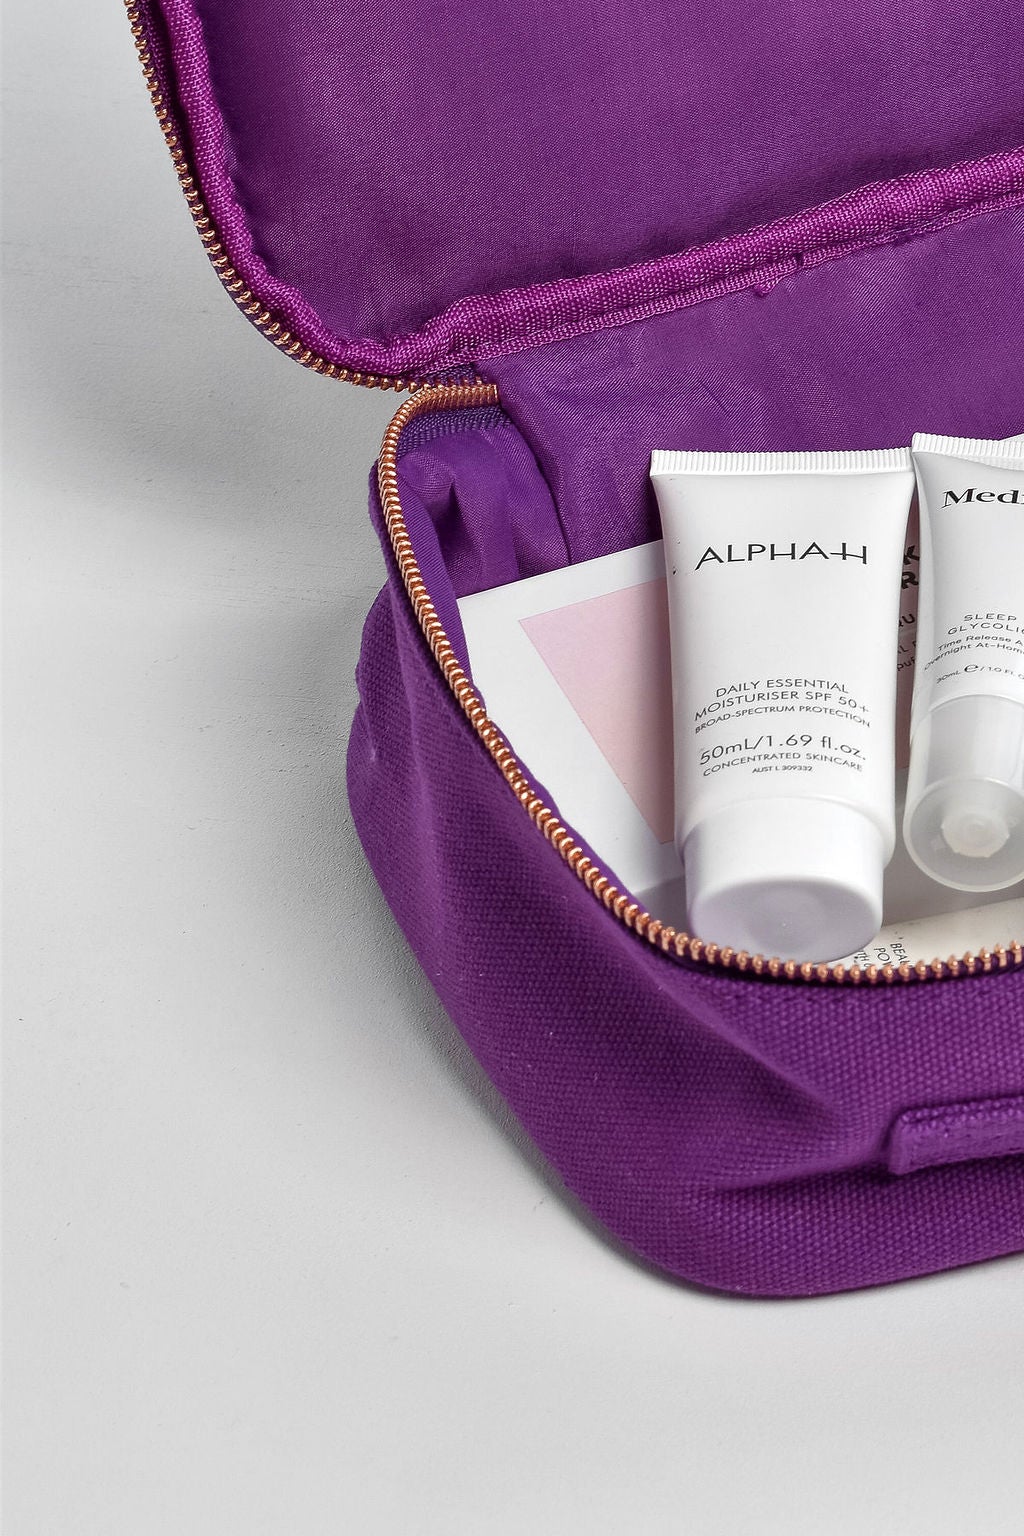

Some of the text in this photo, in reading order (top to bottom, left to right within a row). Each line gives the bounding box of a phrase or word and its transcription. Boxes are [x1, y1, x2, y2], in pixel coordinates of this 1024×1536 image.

[963, 612, 1018, 622] SLEEP
[938, 639, 962, 651] Time
[965, 634, 1012, 643] Release
[924, 643, 972, 671] Overnight
[716, 678, 849, 698] DAILY ESSENTIAL
[694, 690, 870, 721] MOISTURISER SPF 50+
[695, 705, 871, 734] BROAD-SPECTRUM PROTECTION
[702, 752, 863, 777] CONCENTRATED SKINCARE
[751, 765, 773, 774] AUST
